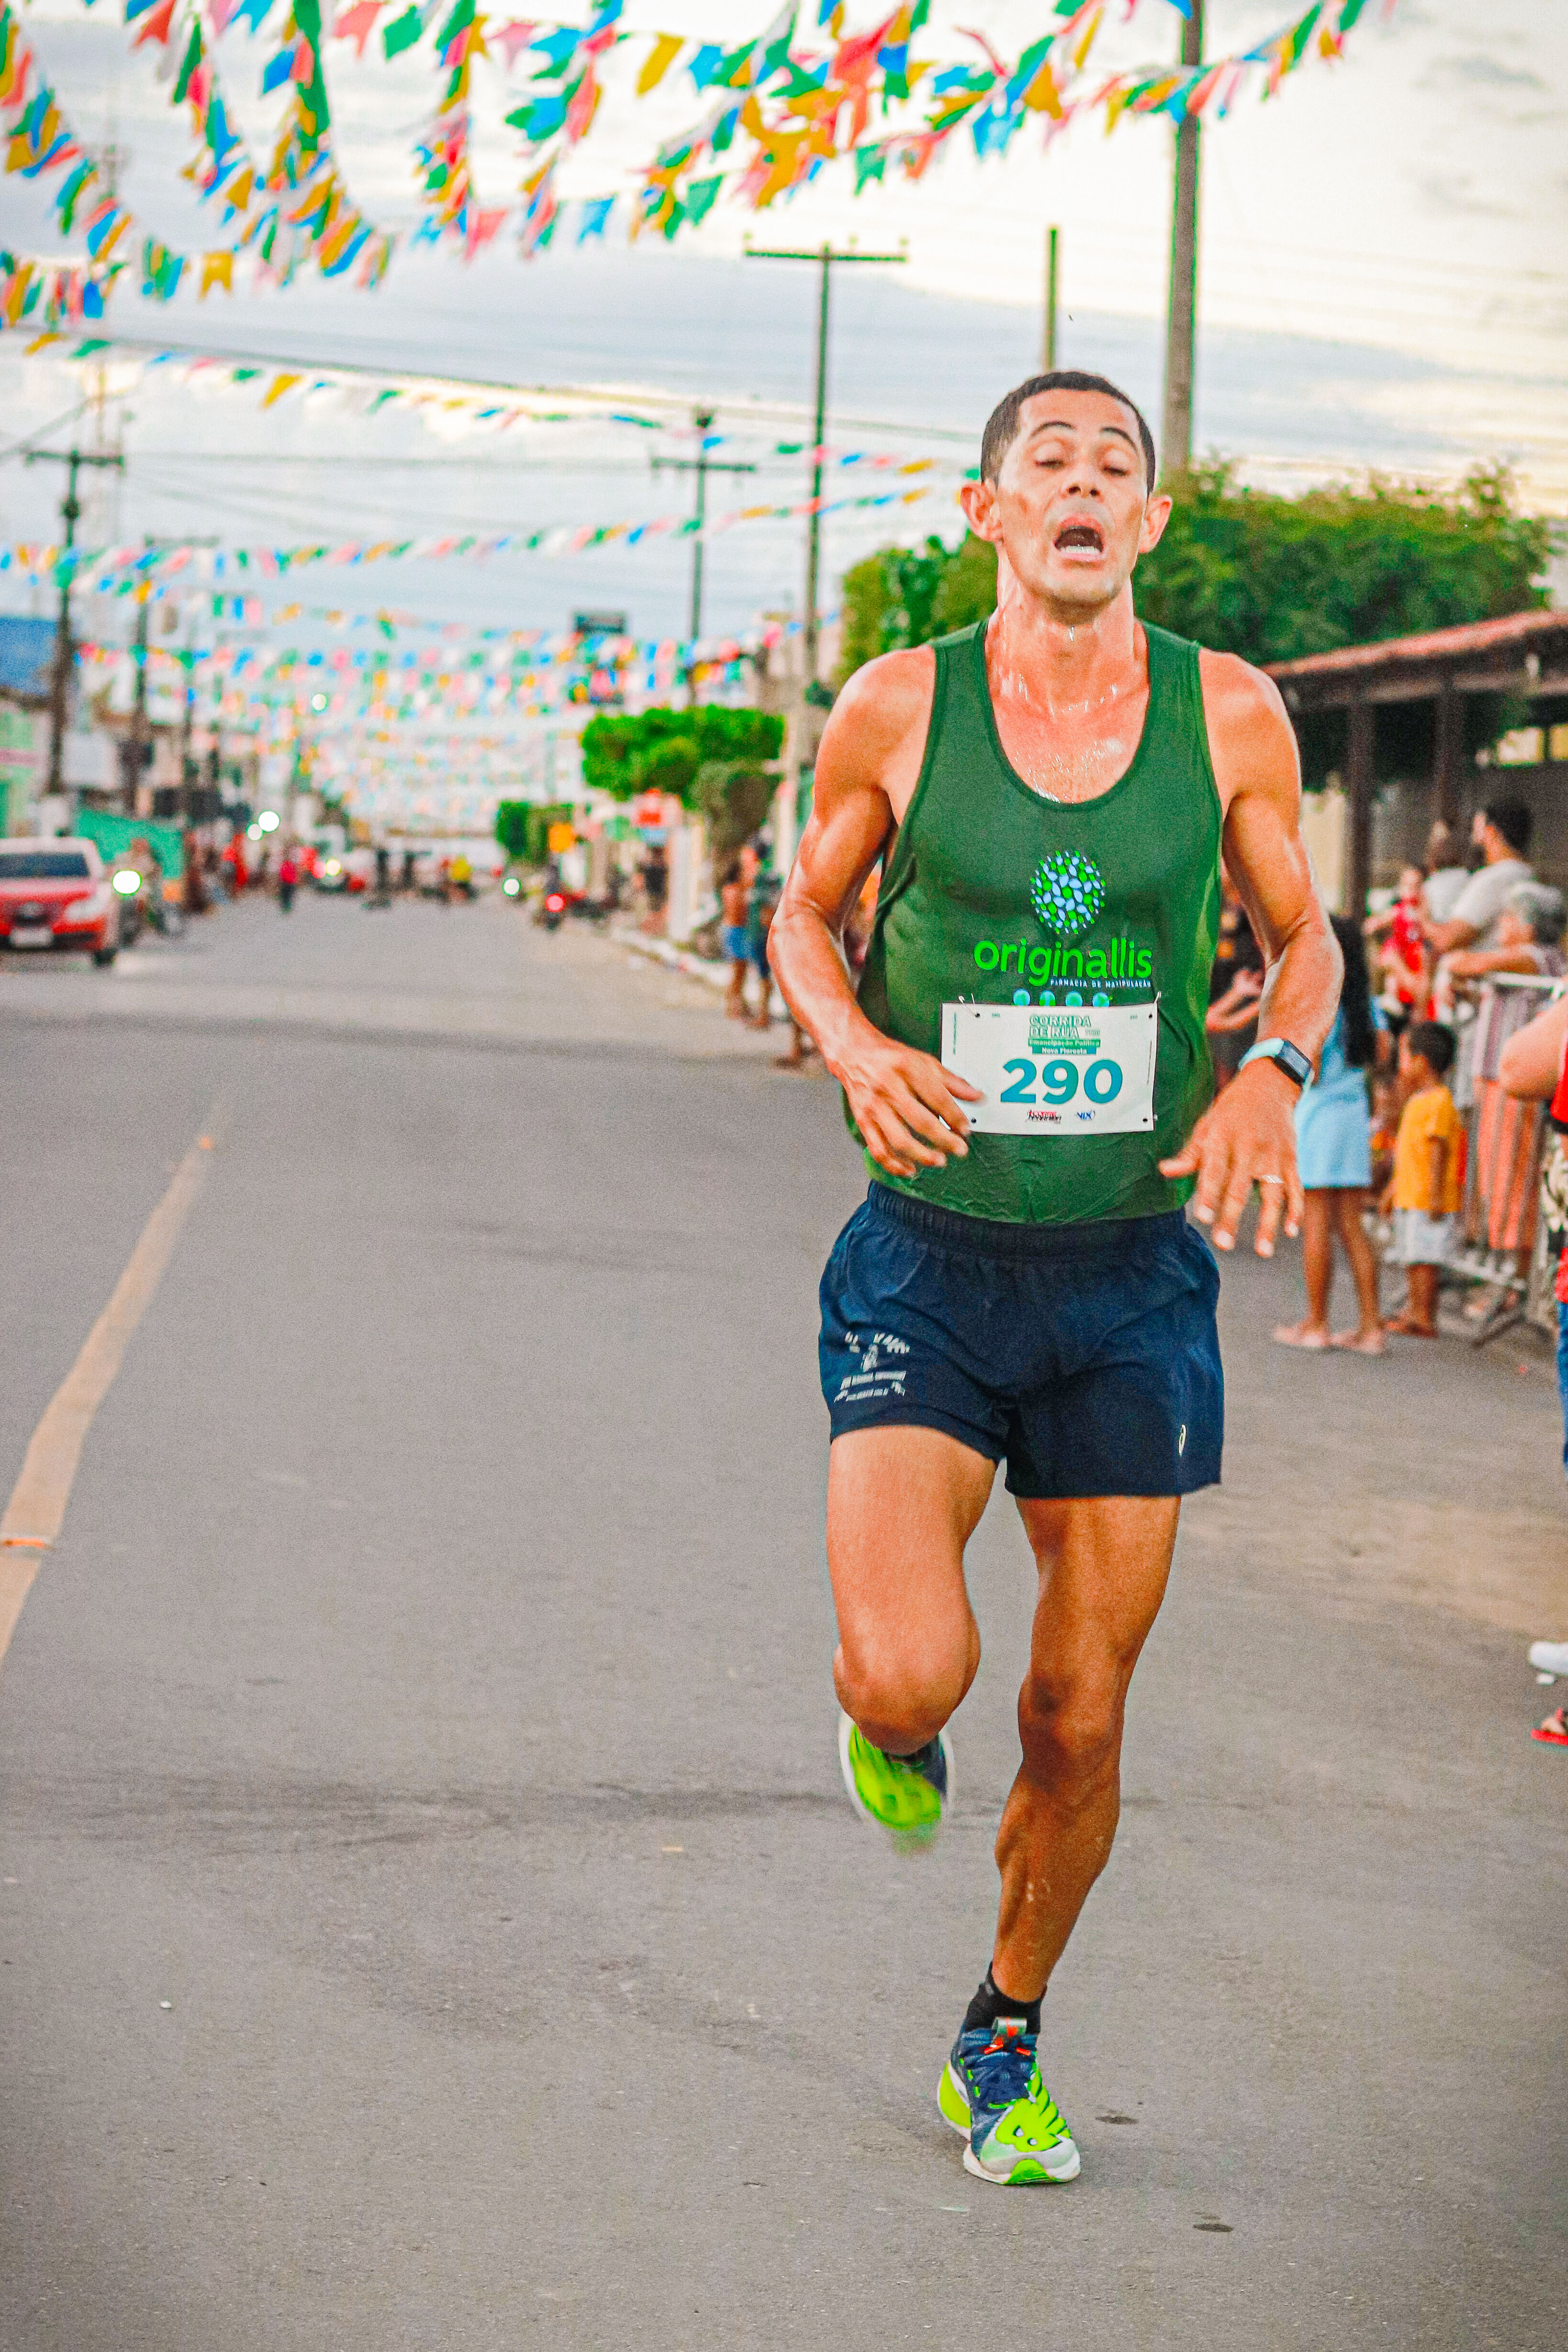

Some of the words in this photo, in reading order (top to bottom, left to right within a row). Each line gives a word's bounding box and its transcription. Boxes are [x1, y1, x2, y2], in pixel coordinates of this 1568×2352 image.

[974, 938, 1152, 986] originallis
[1092, 979, 1101, 988] DE
[1030, 1015, 1091, 1027] CORRIDA
[1030, 1026, 1048, 1038] DE
[1051, 1026, 1080, 1038] RUA
[1000, 1058, 1123, 1104] 290
